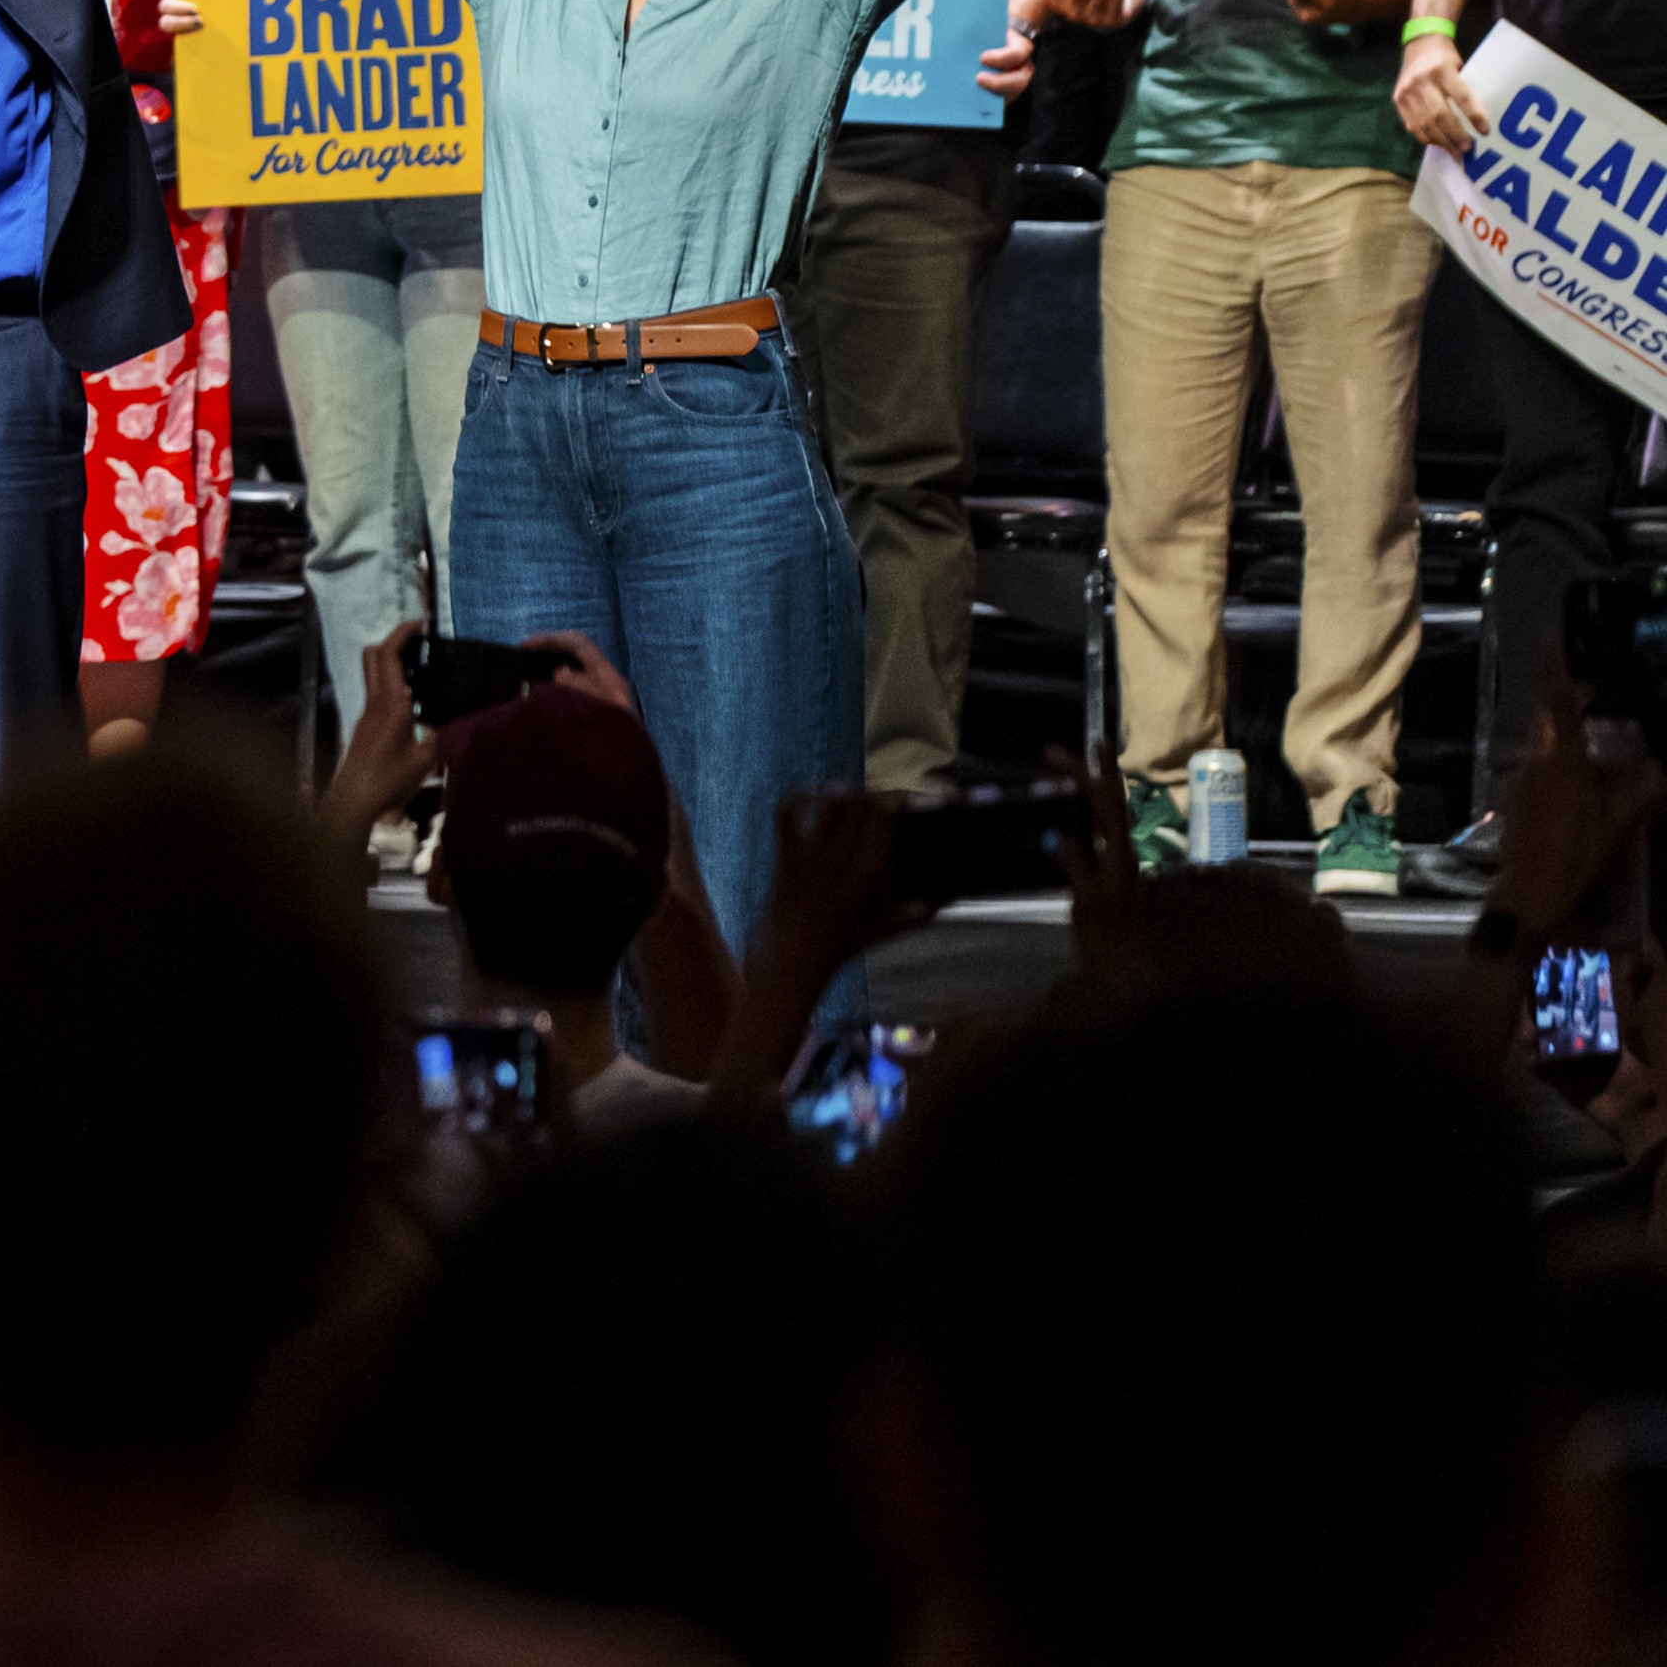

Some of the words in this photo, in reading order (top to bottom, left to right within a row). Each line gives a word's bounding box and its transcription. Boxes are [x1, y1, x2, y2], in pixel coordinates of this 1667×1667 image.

[248, 52, 466, 138] LANDER
[250, 144, 308, 182] for
[317, 136, 465, 183] Congress
[1458, 203, 1509, 256] FOR
[1513, 250, 1667, 370] CONGRES
